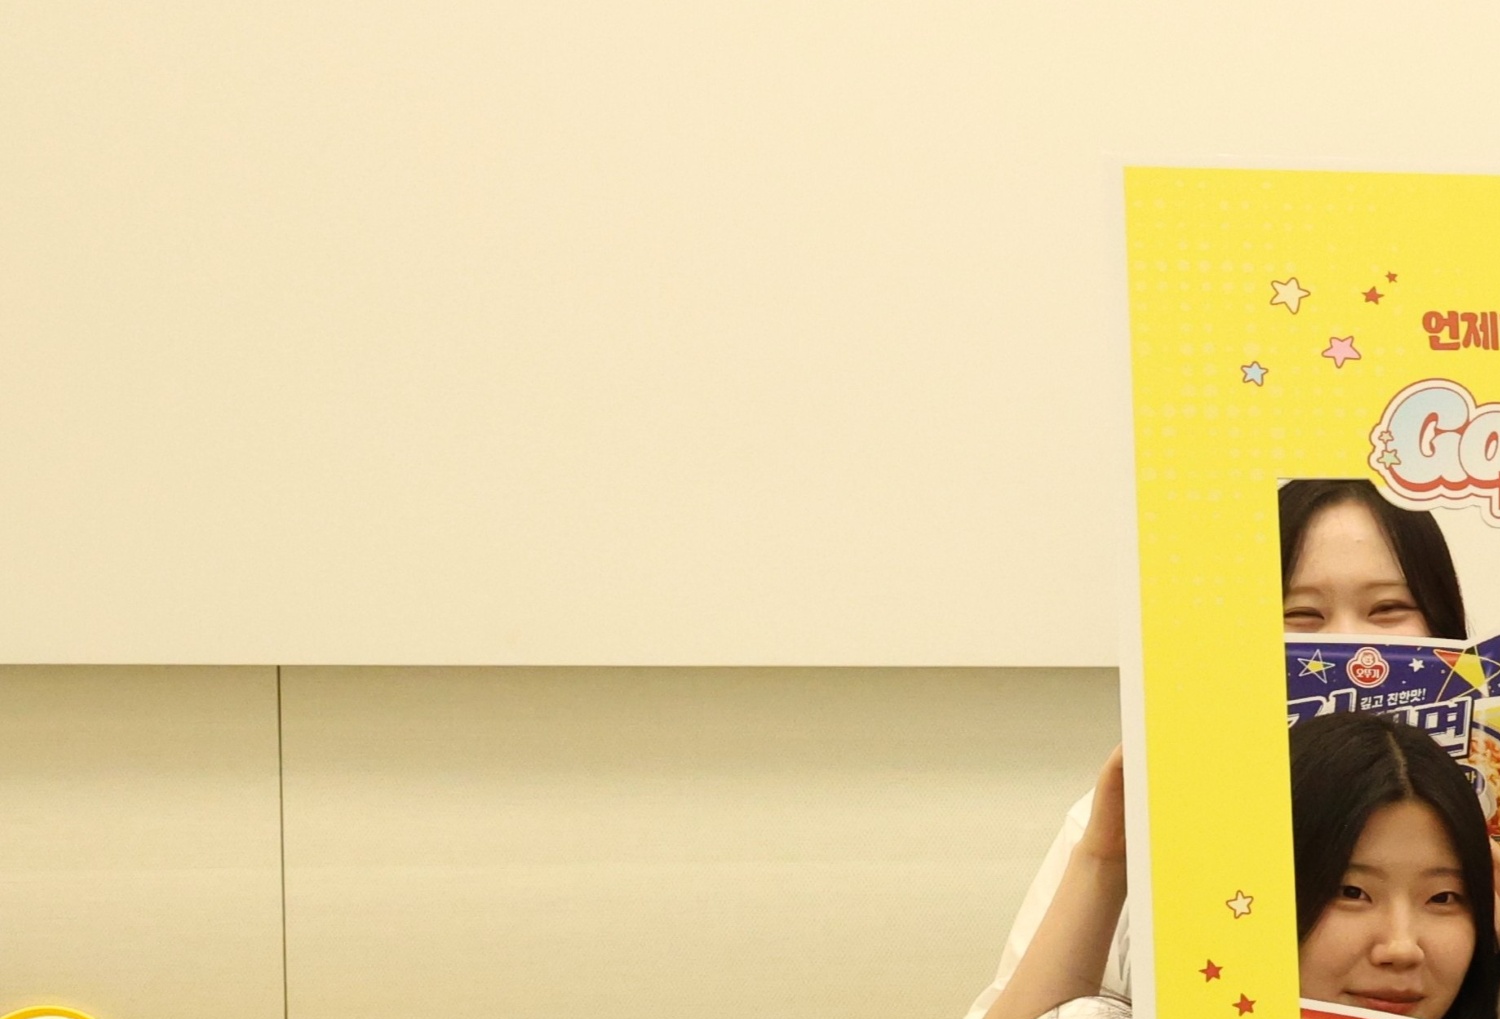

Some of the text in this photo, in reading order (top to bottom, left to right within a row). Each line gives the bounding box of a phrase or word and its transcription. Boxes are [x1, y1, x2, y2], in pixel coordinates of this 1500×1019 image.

[1355, 668, 1381, 680] 오뚜기
[1360, 688, 1427, 711] 깊고 진한맛!
